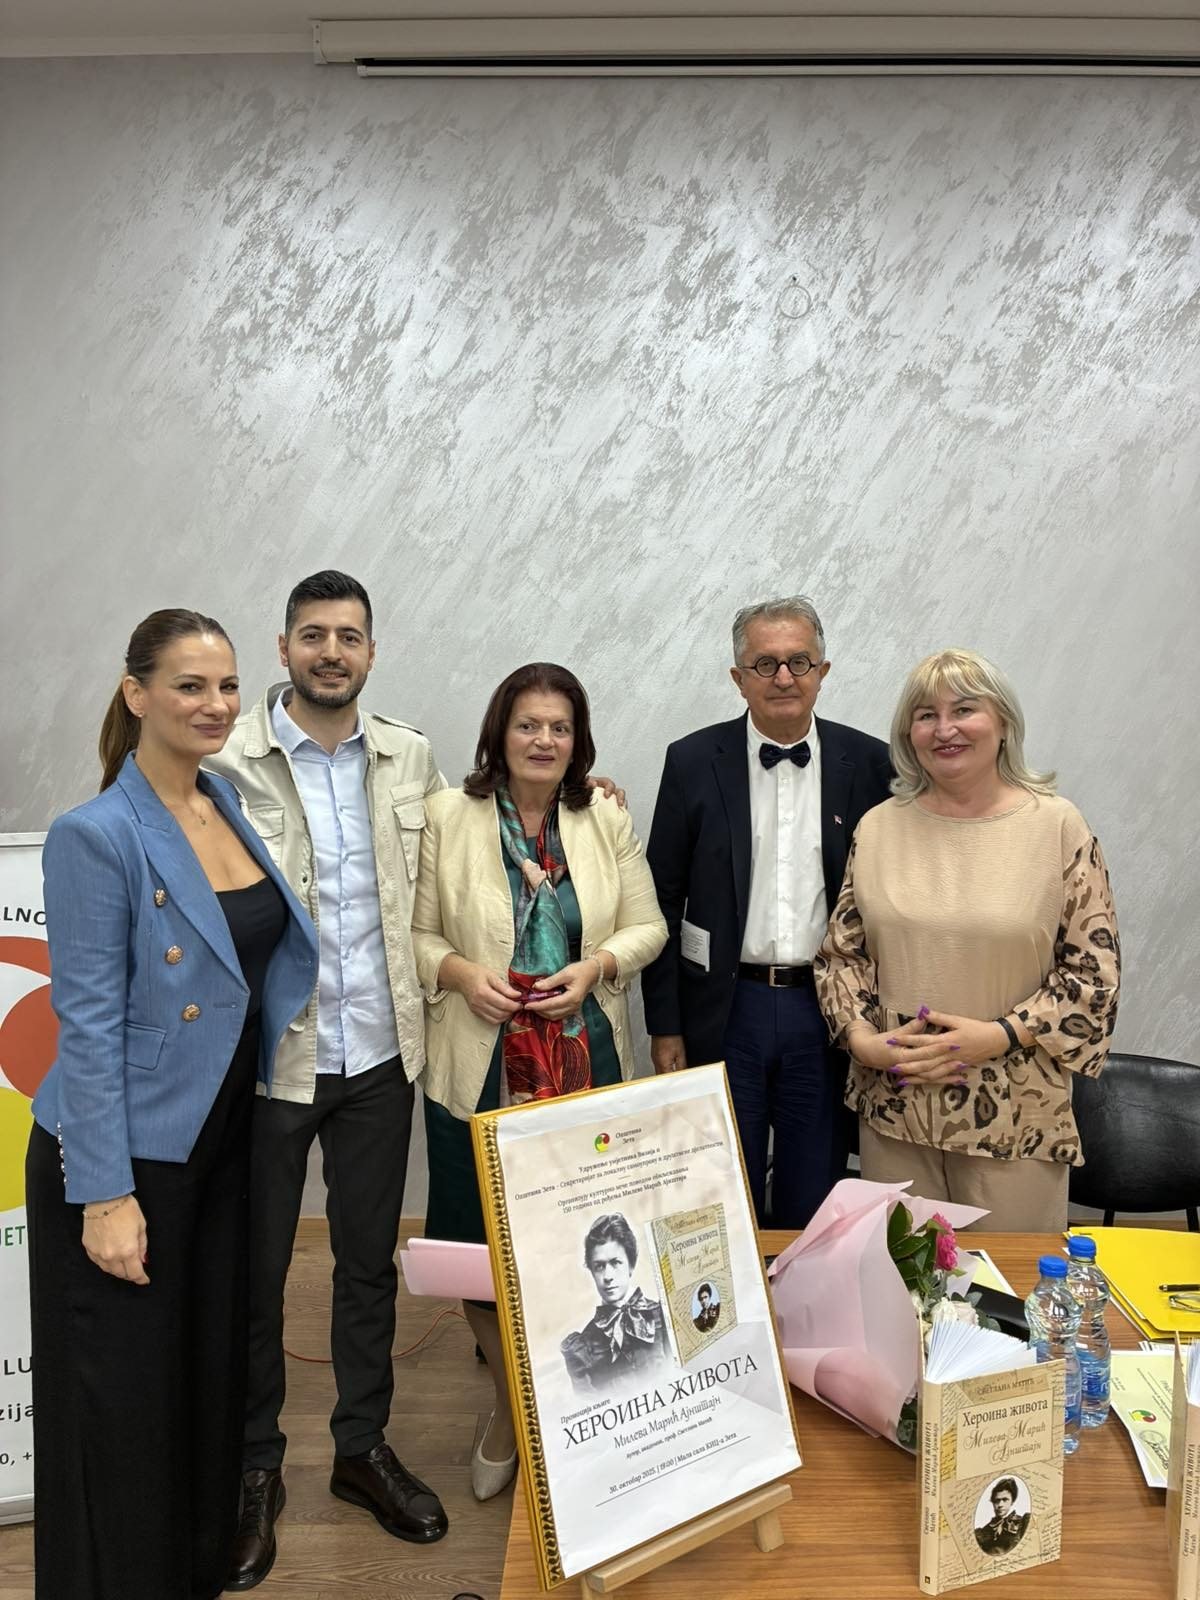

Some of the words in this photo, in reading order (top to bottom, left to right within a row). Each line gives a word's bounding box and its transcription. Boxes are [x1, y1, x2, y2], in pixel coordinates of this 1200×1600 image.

[0, 906, 47, 925] LNO
[514, 1189, 542, 1201] Општина
[542, 1185, 556, 1193] Зета
[559, 1174, 596, 1189] Секретаријат
[603, 1167, 626, 1177] локалну
[0, 1225, 26, 1247] ET
[560, 1407, 592, 1424] Промоција
[592, 1398, 611, 1410] књиге
[563, 1389, 667, 1450] ХЕРОИНА
[668, 1353, 758, 1403] ЖИВОТА
[962, 1408, 1008, 1429] Хероина
[1009, 1399, 1049, 1417] живота
[613, 1427, 649, 1449] Милева
[648, 1409, 680, 1433] Марић
[963, 1426, 1007, 1450] Милева
[1005, 1416, 1046, 1441] Марић
[619, 1476, 642, 1490] октобар
[725, 1432, 737, 1443] Зета
